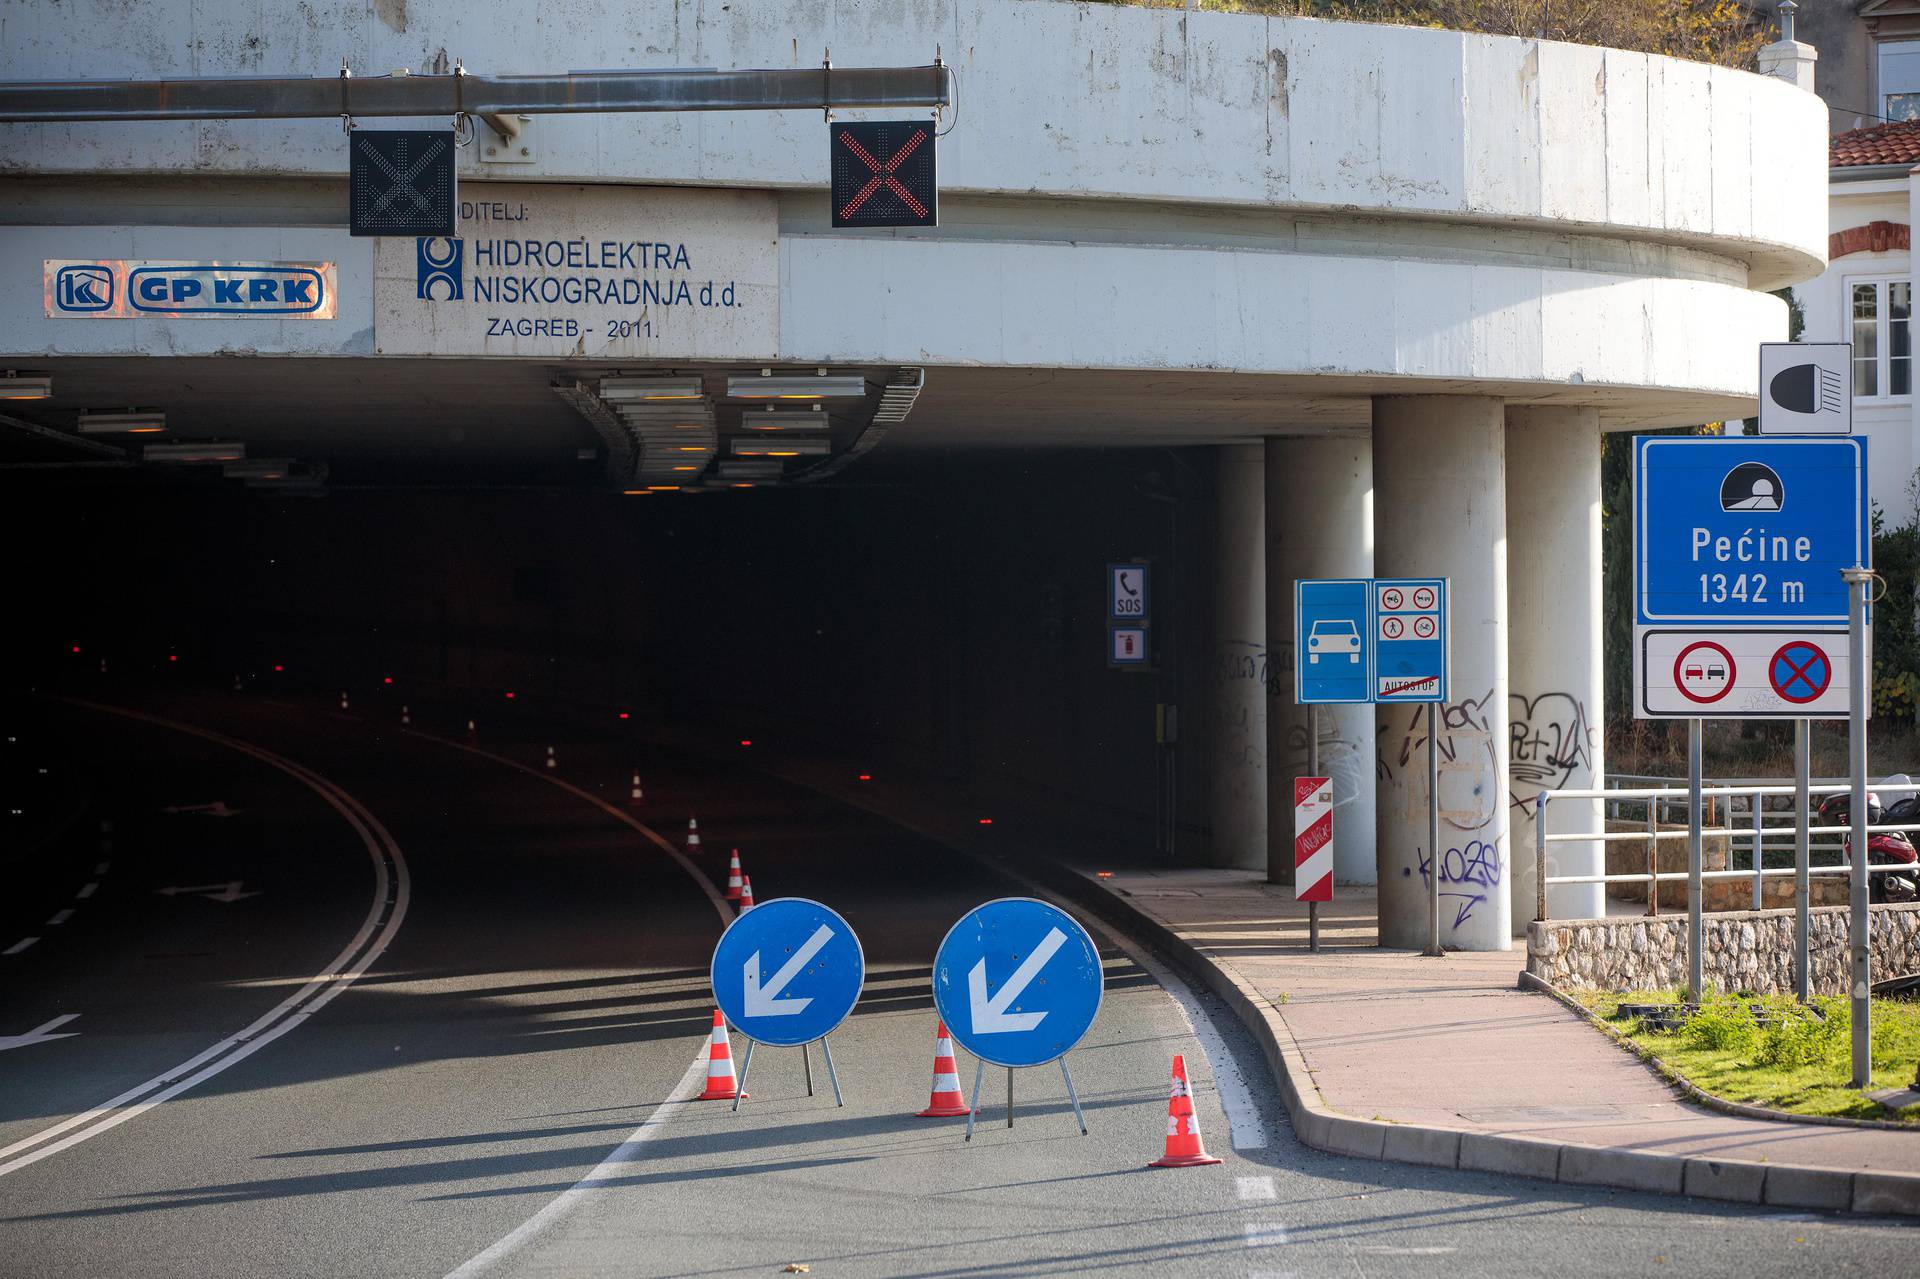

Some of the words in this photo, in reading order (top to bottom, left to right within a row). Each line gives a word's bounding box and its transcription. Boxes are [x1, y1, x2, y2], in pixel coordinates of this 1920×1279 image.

[457, 201, 529, 221] DITELJ:
[474, 239, 691, 270] HIDROELEKTRA
[139, 277, 202, 303] GP
[214, 278, 313, 304] KRK
[473, 276, 693, 306] NISKOGRADNJA
[699, 281, 743, 308] d.d.
[486, 317, 580, 338] ZAGREB
[607, 319, 660, 339] 2011.
[1691, 527, 1811, 562] Pećine
[1699, 573, 1768, 603] 1342
[1781, 580, 1805, 603] m
[1117, 599, 1141, 613] SOS
[1384, 681, 1435, 692] AUTOSTOP
